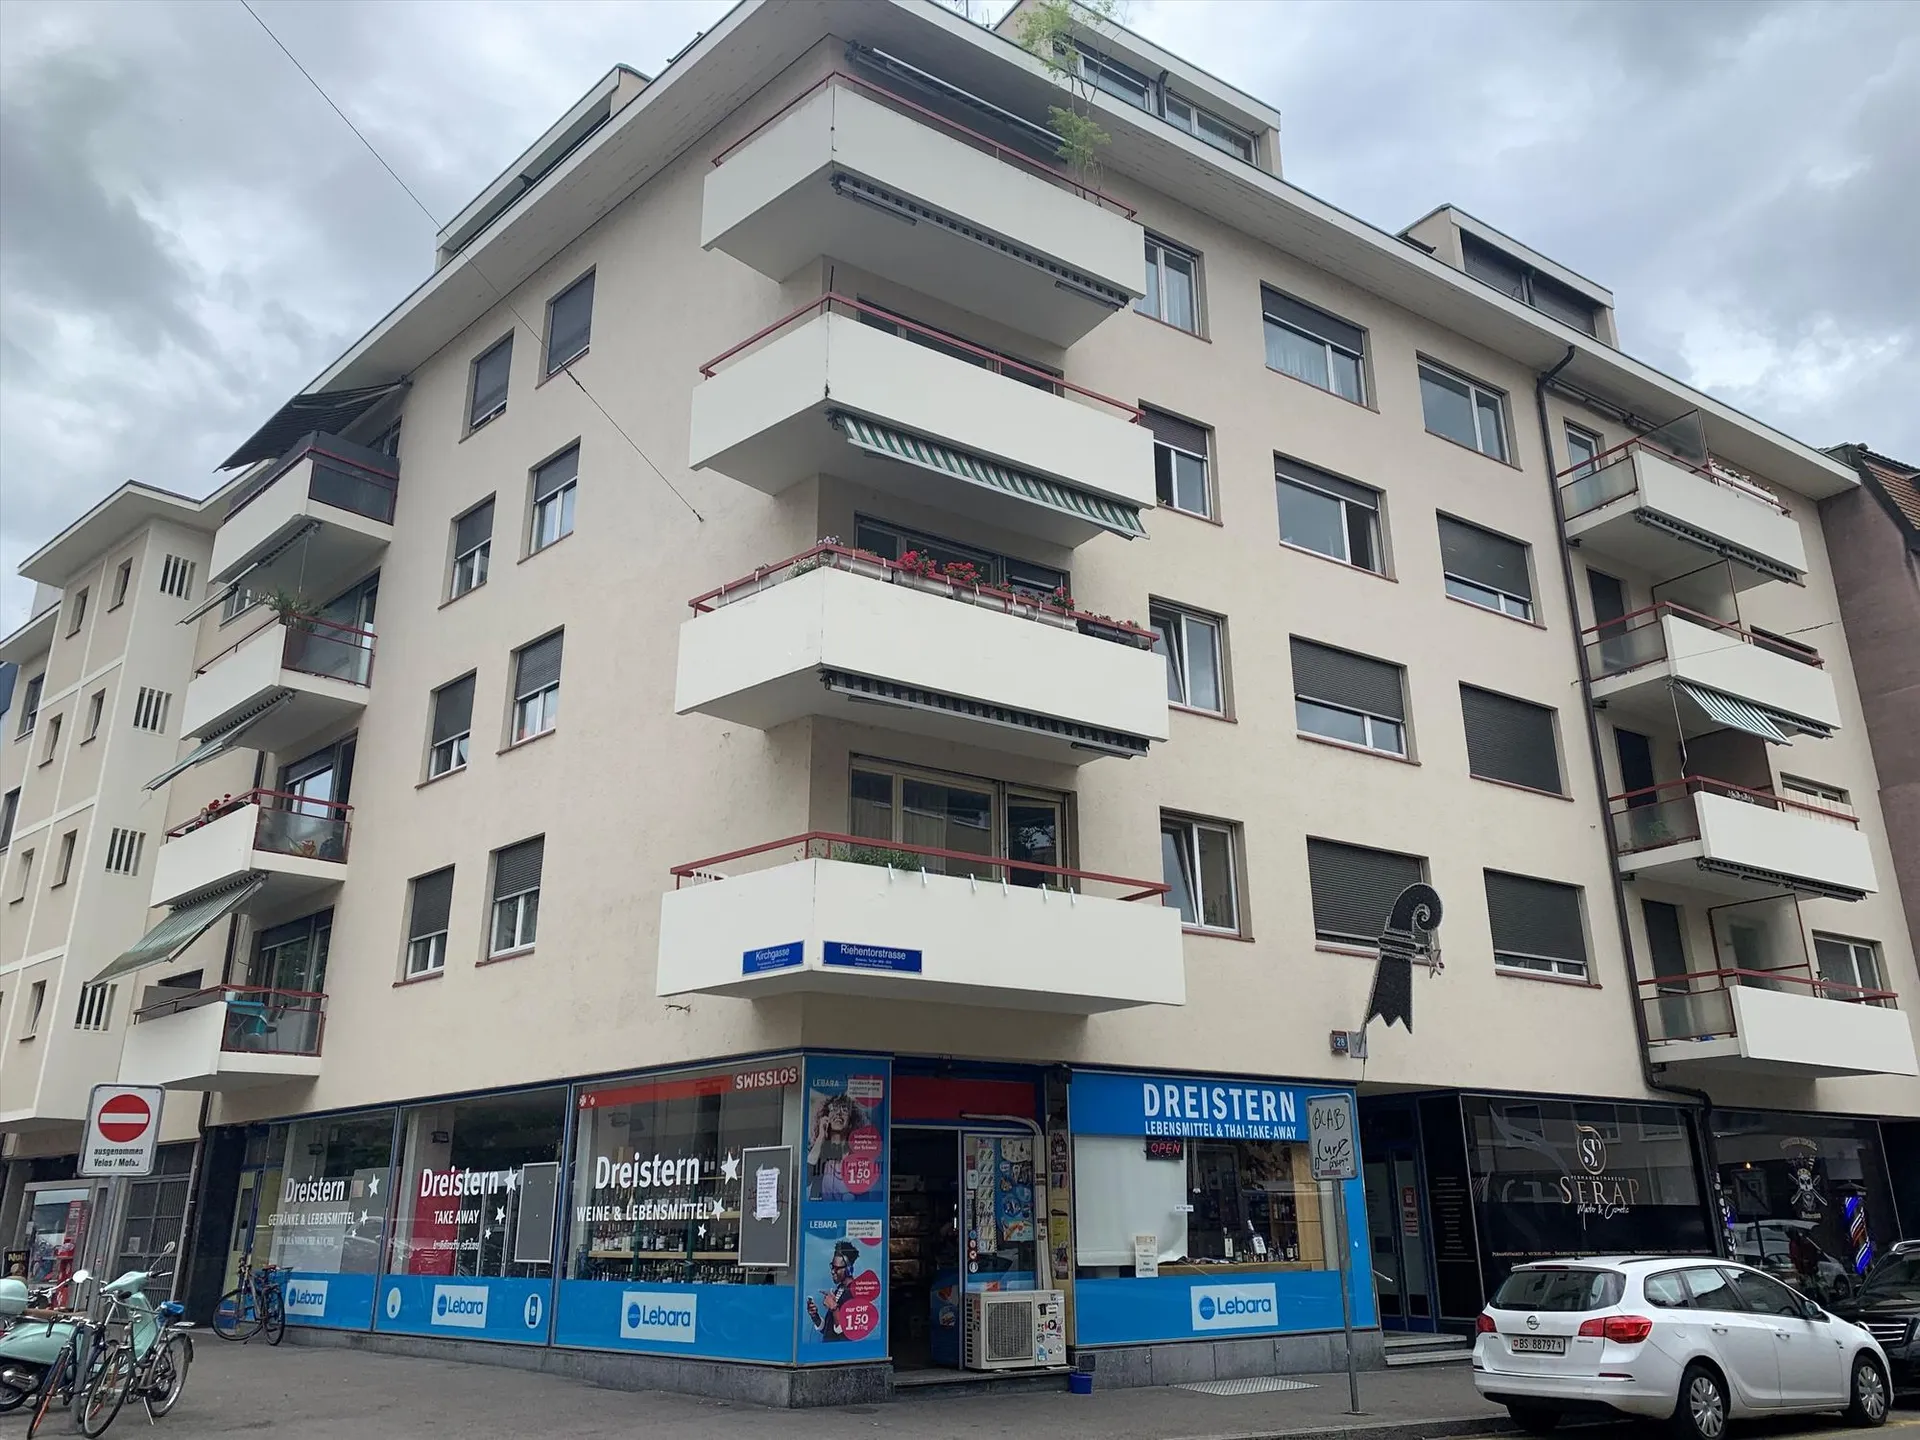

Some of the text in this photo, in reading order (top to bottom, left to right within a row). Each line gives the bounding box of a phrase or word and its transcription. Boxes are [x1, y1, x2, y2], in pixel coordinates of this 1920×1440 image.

[755, 948, 790, 961] Kirchgasse
[840, 944, 906, 960] Riehentorstrasse
[1336, 1037, 1346, 1047] 28
[736, 1068, 798, 1089] SWISSLOS
[813, 1079, 840, 1088] LEBARA
[1143, 1083, 1296, 1123] DREISTERN
[1145, 1121, 1214, 1137] LEBENSMITTEL
[1216, 1124, 1224, 1137] &
[94, 1148, 144, 1156] ausgenommen
[1150, 1143, 1181, 1154] OPEN
[94, 1158, 113, 1167] Velos
[595, 1152, 700, 1190] Dreistern
[284, 1175, 345, 1203] Dreistern
[420, 1165, 499, 1197] Dreistern
[1560, 1176, 1639, 1205] SERAP
[268, 1212, 355, 1226] GETRÄNKE & LEBENSMITTEL
[434, 1209, 480, 1224] TAKE AWAY
[577, 1203, 710, 1221] WEINE & LEBENSMITTEL
[809, 1220, 838, 1229] LEBARA
[296, 1289, 324, 1305] Lebara
[448, 1297, 484, 1315] Lebara
[1217, 1296, 1272, 1315] Lebara
[642, 1305, 691, 1327] Lebara
[1519, 1338, 1556, 1350] BS 88797
